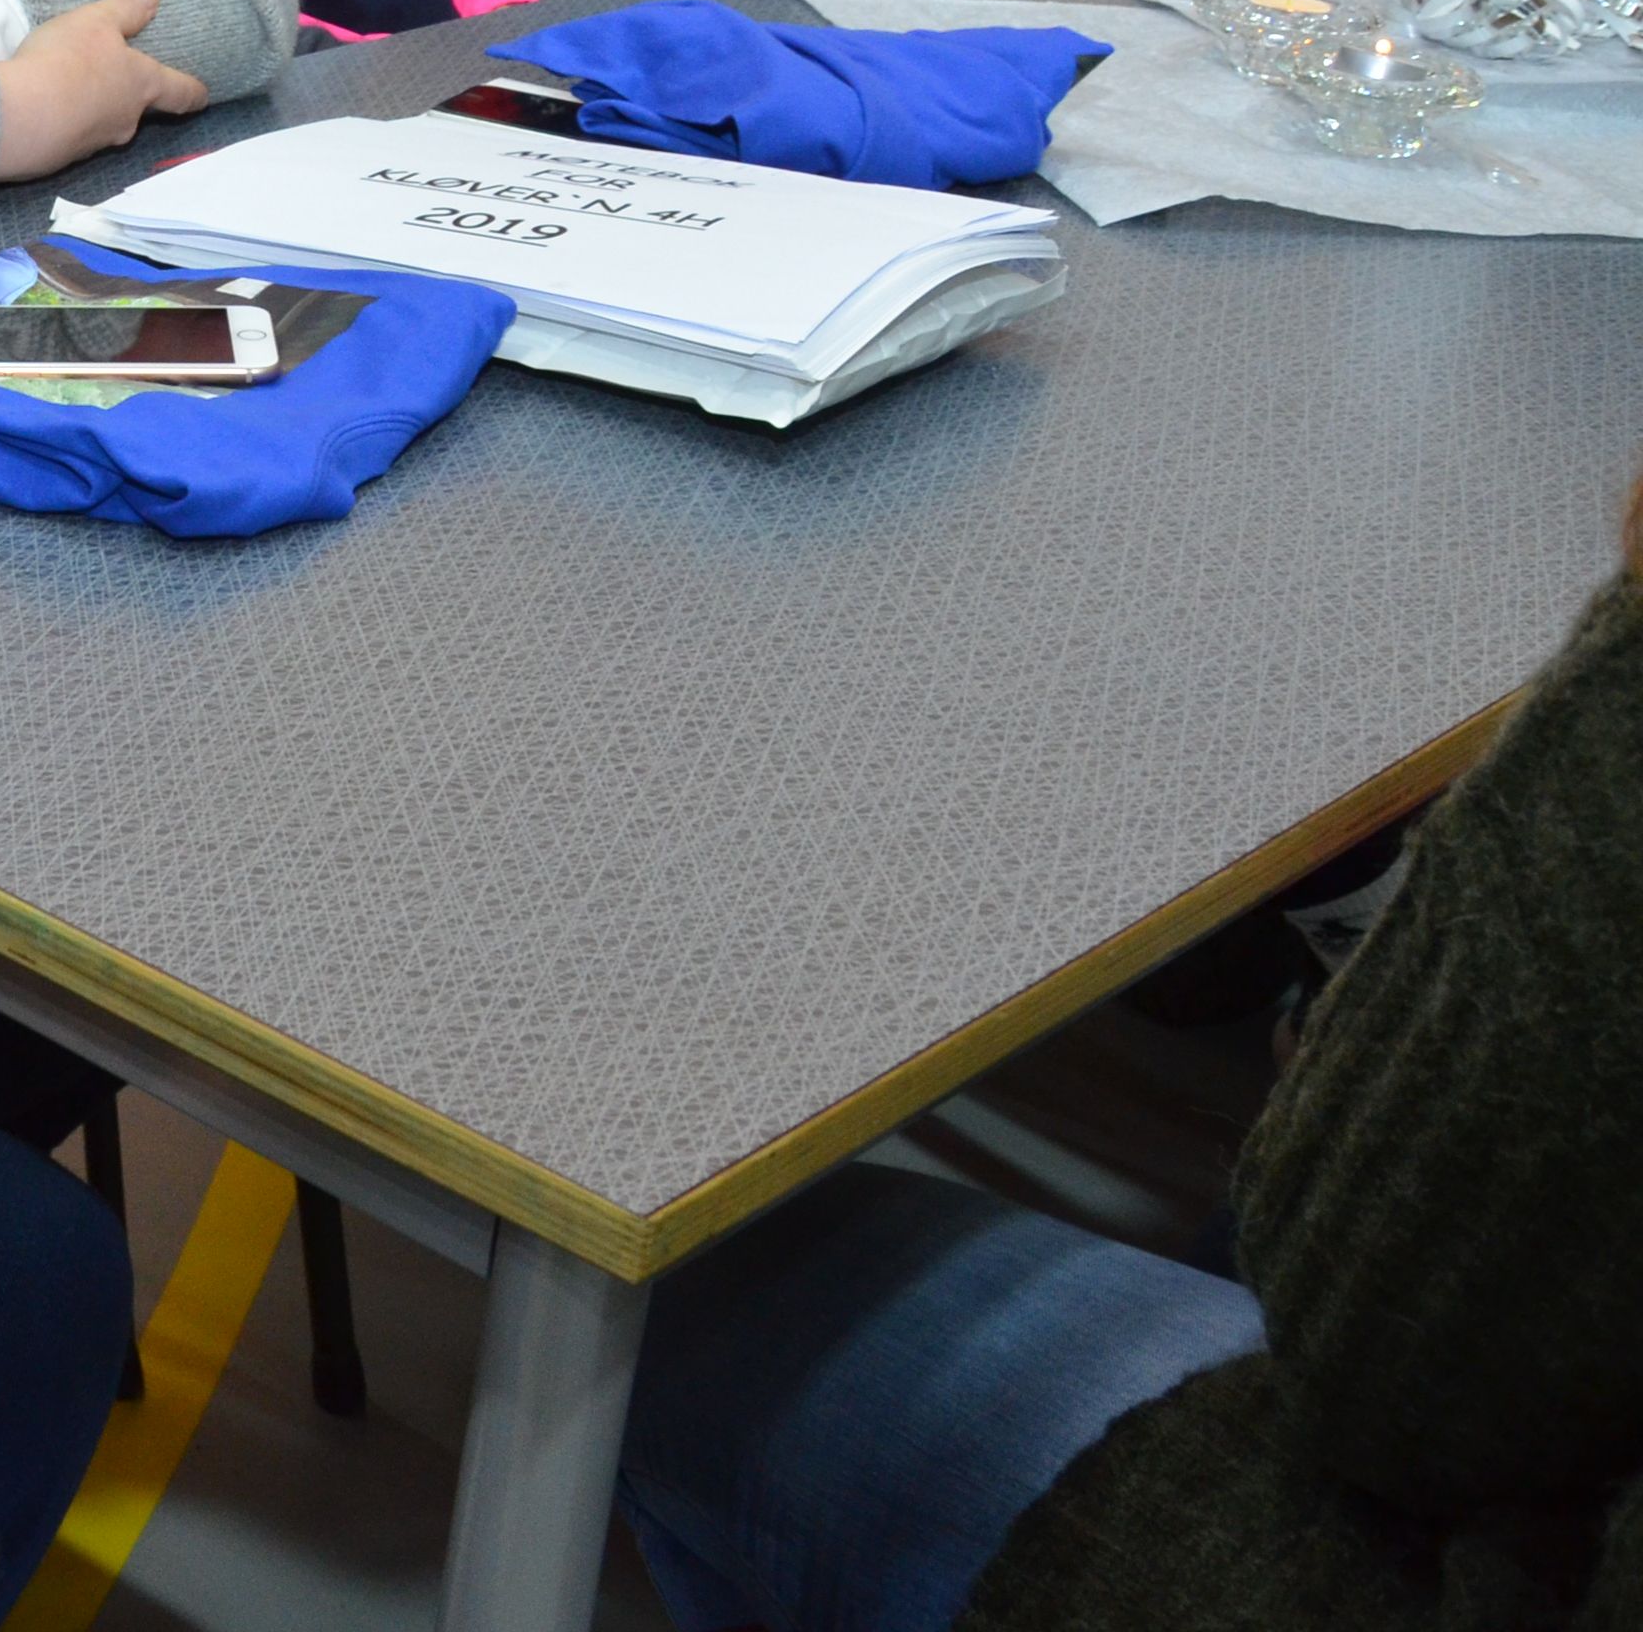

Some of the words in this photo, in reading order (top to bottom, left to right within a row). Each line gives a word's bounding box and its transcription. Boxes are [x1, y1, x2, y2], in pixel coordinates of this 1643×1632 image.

[503, 150, 755, 188] MØTEBOK
[531, 169, 636, 190] FOR
[414, 206, 569, 241] 2019
[647, 210, 726, 228] 4H
